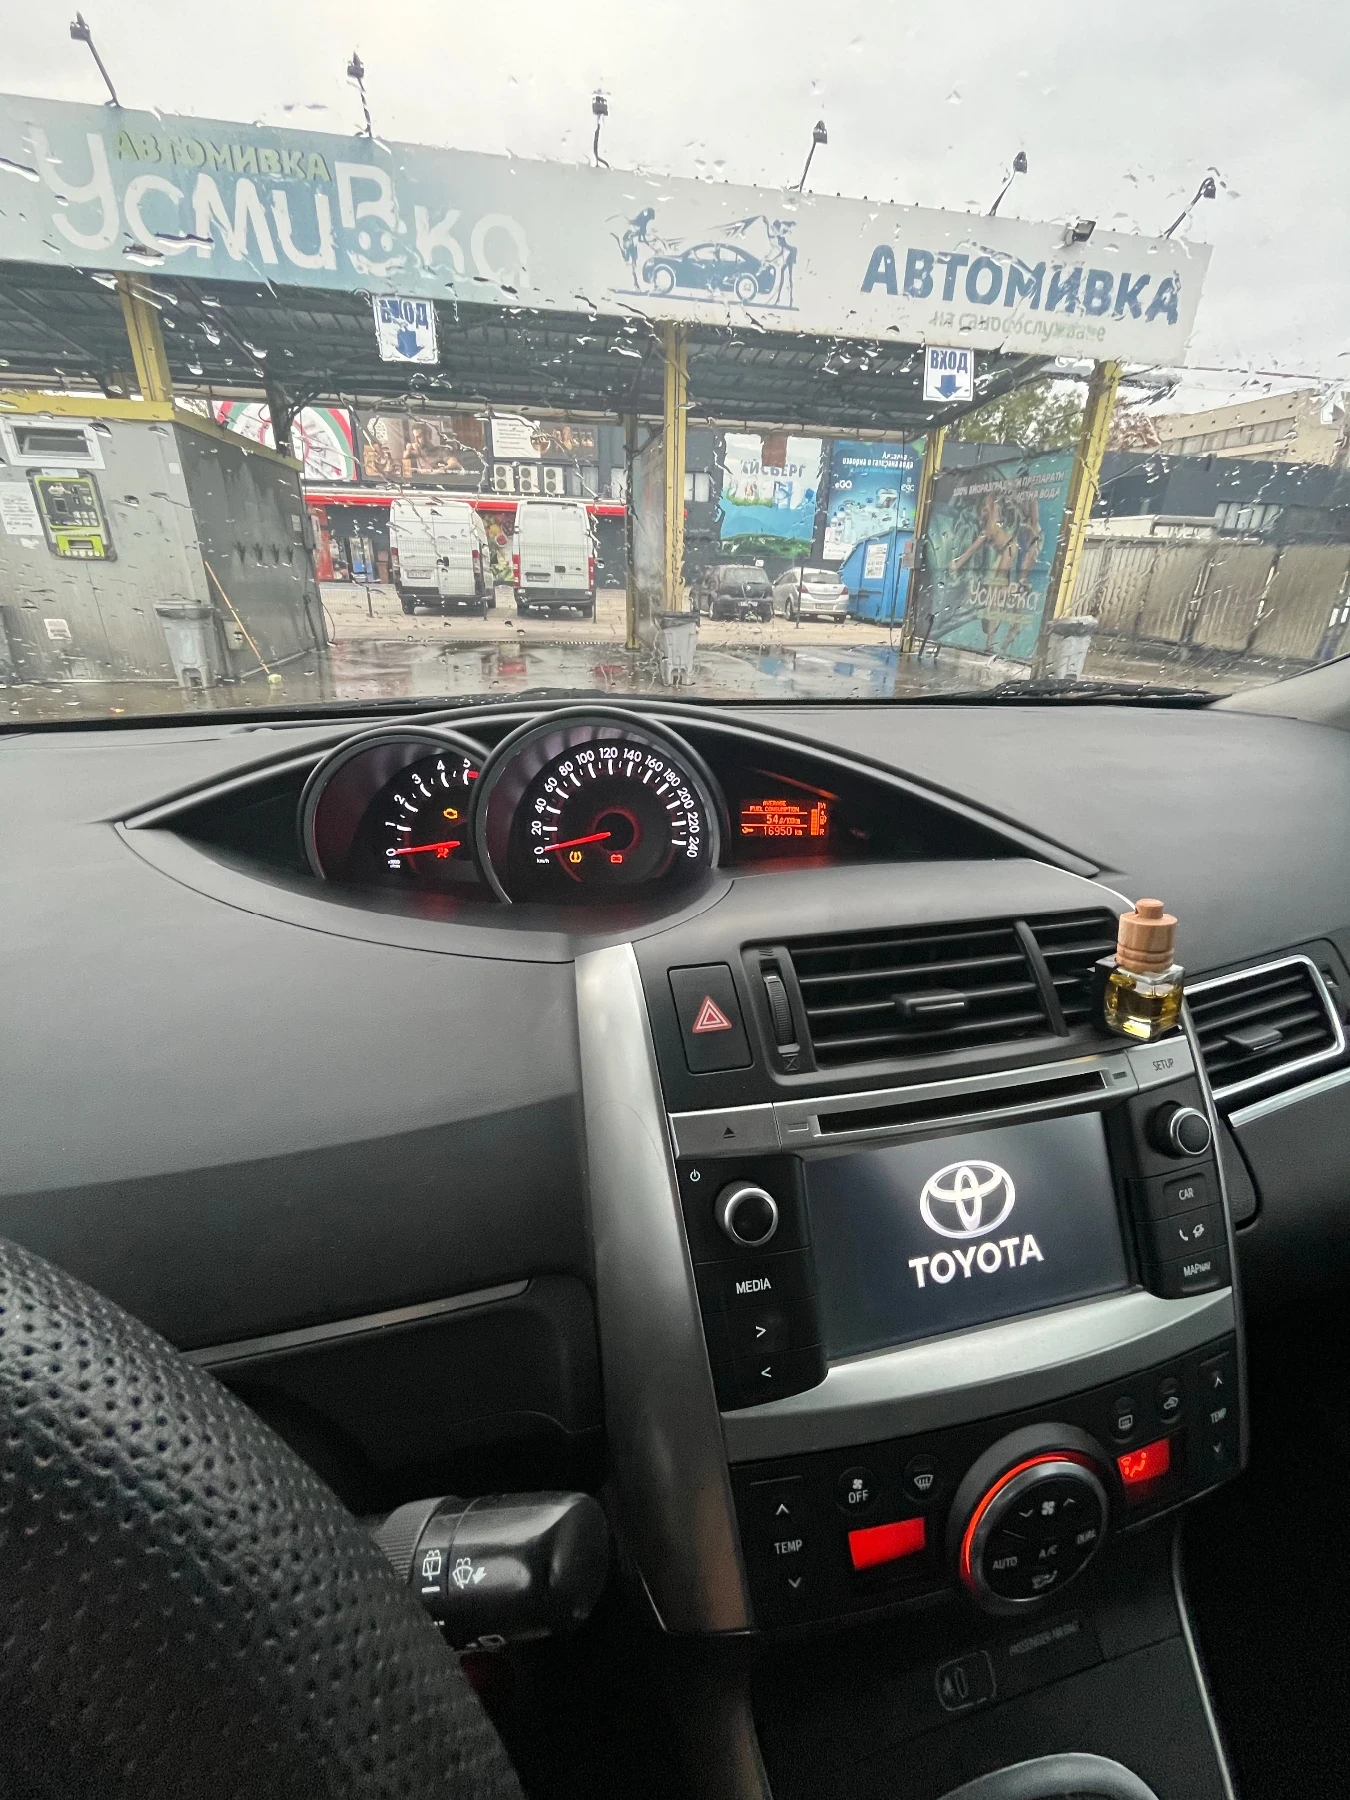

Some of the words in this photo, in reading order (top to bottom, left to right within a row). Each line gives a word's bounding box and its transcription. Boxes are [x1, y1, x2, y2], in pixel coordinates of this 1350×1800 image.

[116, 129, 333, 182] АВТОМИВКА
[860, 243, 1182, 326] АВТОМИВКА
[930, 349, 968, 375] ВХОД
[575, 750, 595, 766] 100
[599, 747, 618, 758] 120
[623, 748, 642, 762] 140
[436, 759, 446, 770] 4
[558, 761, 574, 776] 80
[644, 755, 663, 772] 160
[411, 773, 421, 784] 3
[544, 777, 558, 793] 60
[662, 768, 681, 787] 180
[394, 794, 406, 804] 2
[534, 797, 547, 814] 40
[676, 787, 694, 809] 200
[531, 820, 542, 835] 20
[687, 812, 700, 833] 220
[763, 826, 793, 836] 16950
[820, 828, 825, 836] R
[386, 848, 396, 856] 0
[533, 846, 544, 855] 0
[686, 836, 700, 858] 240
[1152, 1058, 1174, 1071] SETUP
[1178, 1187, 1194, 1200] CAR
[908, 1234, 1044, 1288] TOYOTA
[735, 1277, 772, 1294] MEDIA
[1210, 1407, 1227, 1423] TEMP
[848, 1489, 869, 1504] OFF
[774, 1539, 803, 1555] TEMP
[1039, 1545, 1058, 1559] A/C
[993, 1556, 1018, 1570] AUTO
